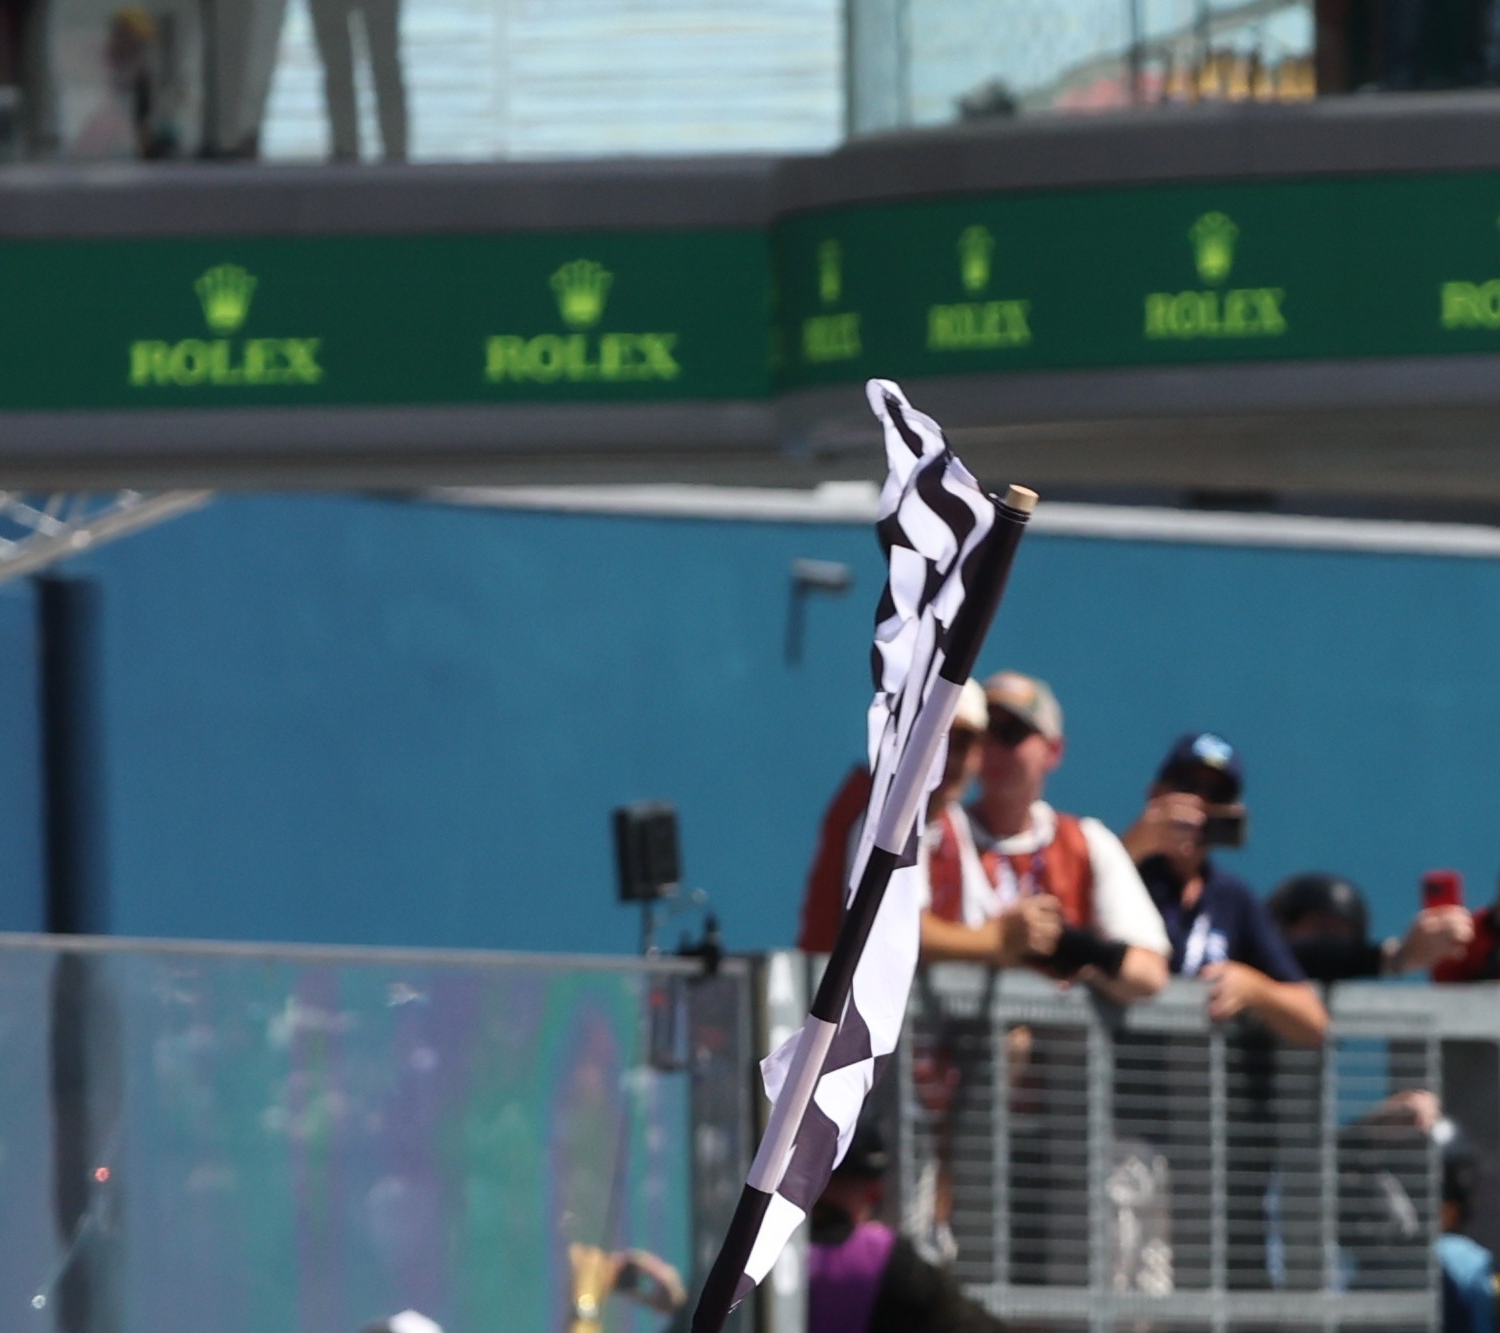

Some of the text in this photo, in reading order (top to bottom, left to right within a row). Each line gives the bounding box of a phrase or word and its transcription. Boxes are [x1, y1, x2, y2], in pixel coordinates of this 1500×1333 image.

[1145, 288, 1285, 337] ROLEX
[131, 339, 321, 384] ROLEX
[486, 334, 678, 380] ROLEX
